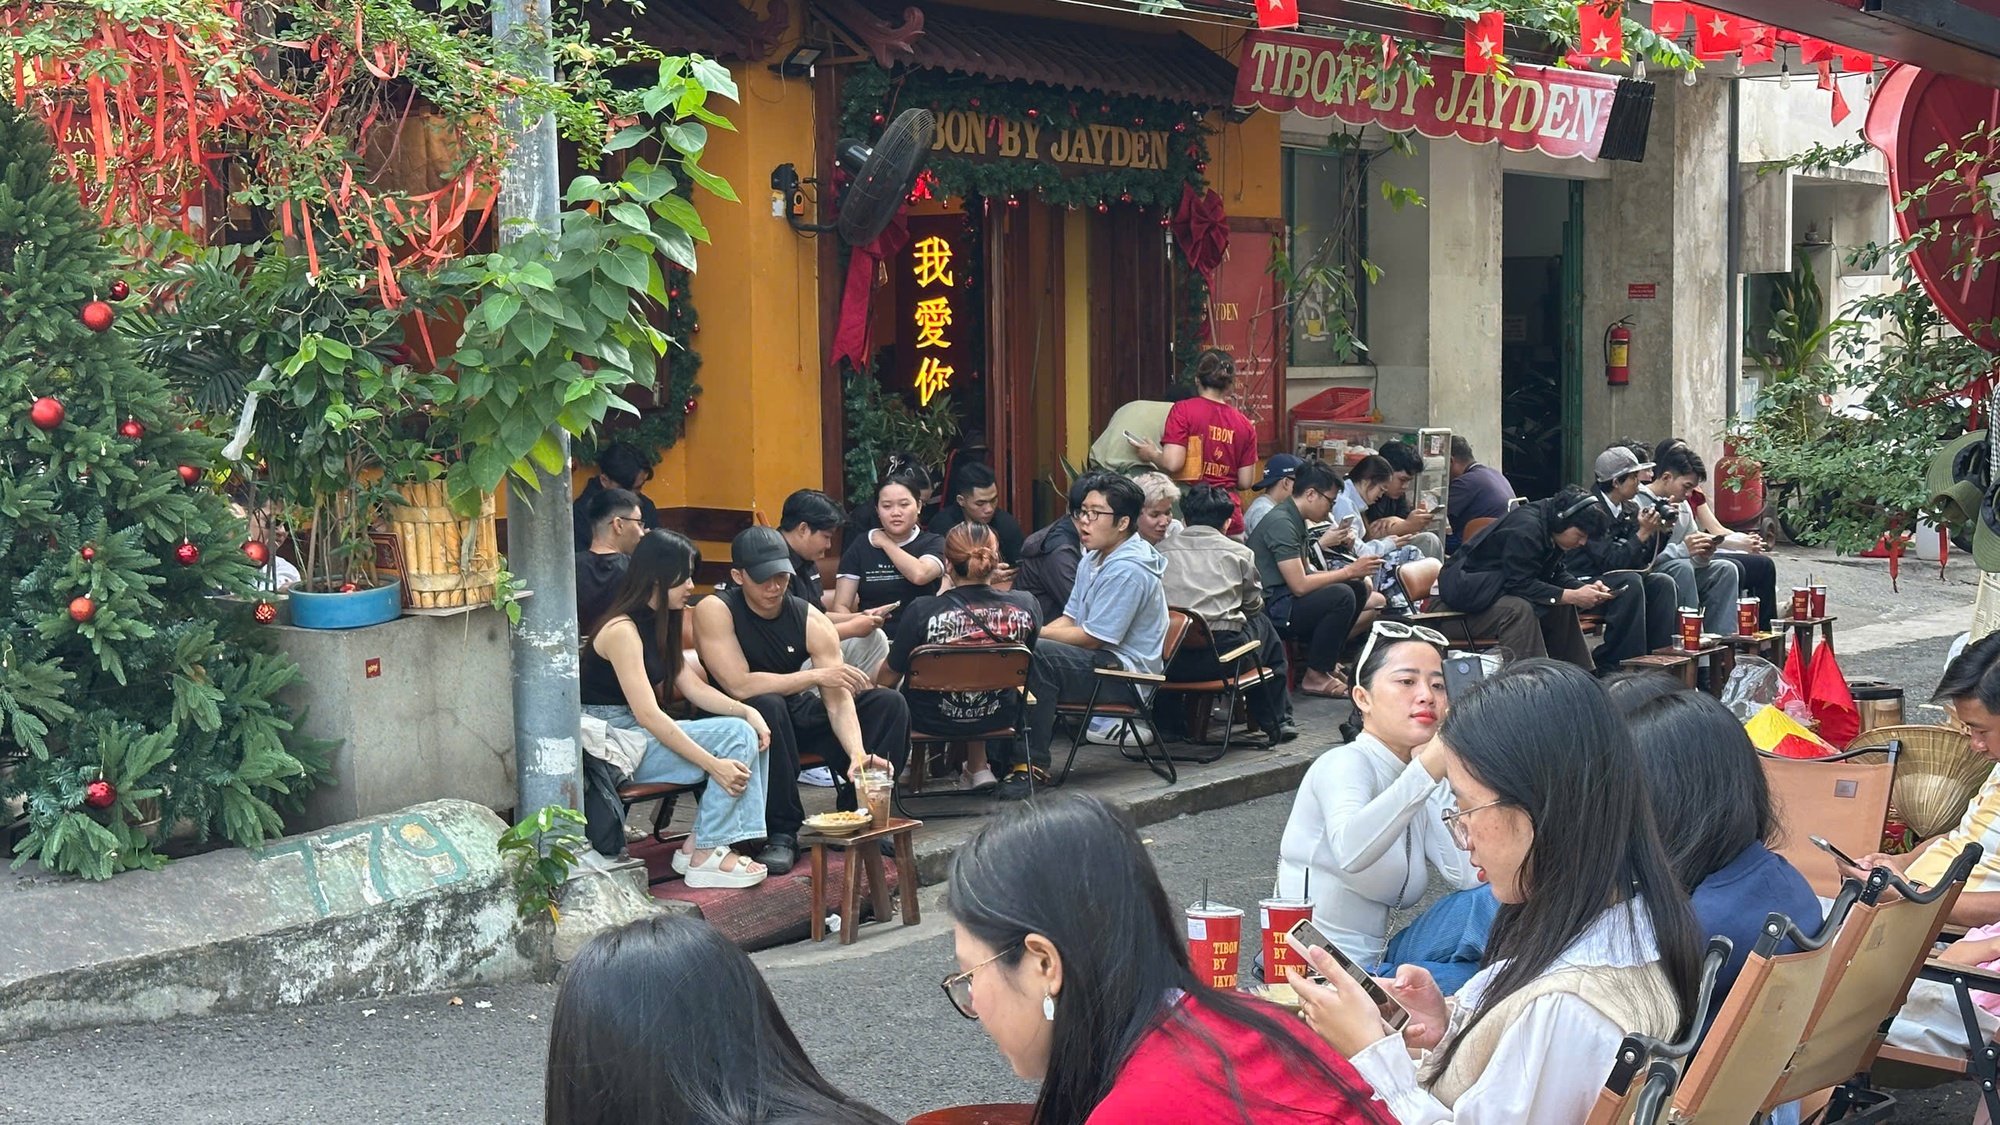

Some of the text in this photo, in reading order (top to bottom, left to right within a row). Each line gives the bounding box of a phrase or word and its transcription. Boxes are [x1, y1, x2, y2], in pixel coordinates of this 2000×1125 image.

[1251, 42, 1611, 143] TIBON BY JAYDEN
[932, 110, 1169, 170] BON BY JAYDEN
[913, 235, 955, 407] 我愛你
[1208, 425, 1235, 444] TIBON
[252, 813, 470, 917] 779
[1213, 941, 1238, 954] TIBON
[1213, 957, 1227, 970] BY
[1273, 947, 1287, 960] BY
